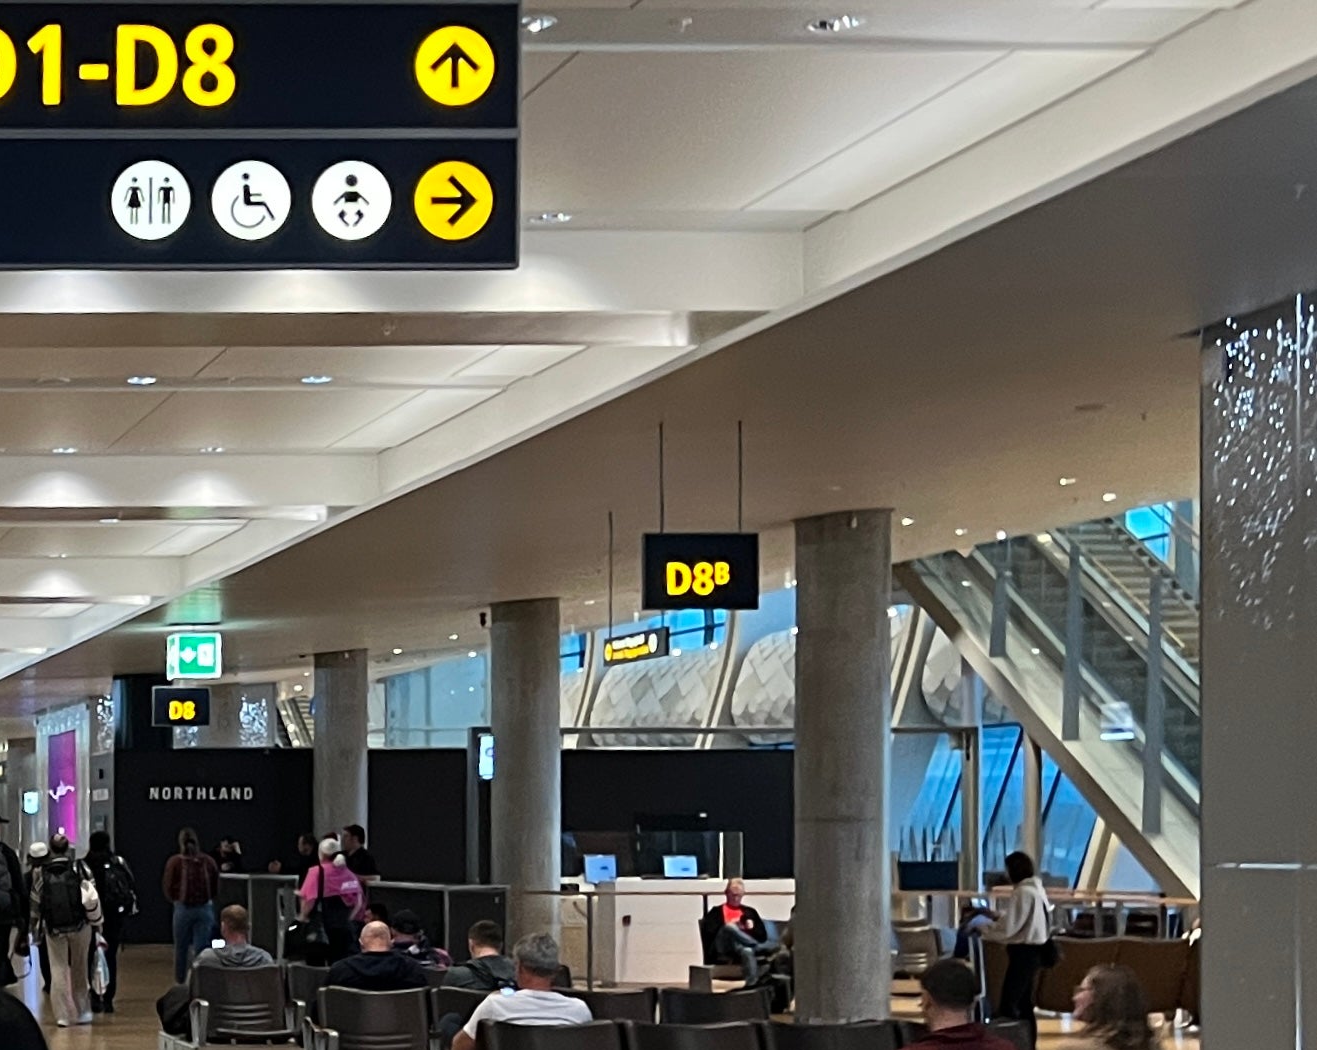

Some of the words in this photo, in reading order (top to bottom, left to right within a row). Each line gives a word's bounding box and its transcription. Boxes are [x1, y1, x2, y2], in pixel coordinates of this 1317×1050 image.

[666, 561, 731, 596] D8B
[168, 700, 196, 720] D8
[149, 787, 253, 800] NORTHLAND
